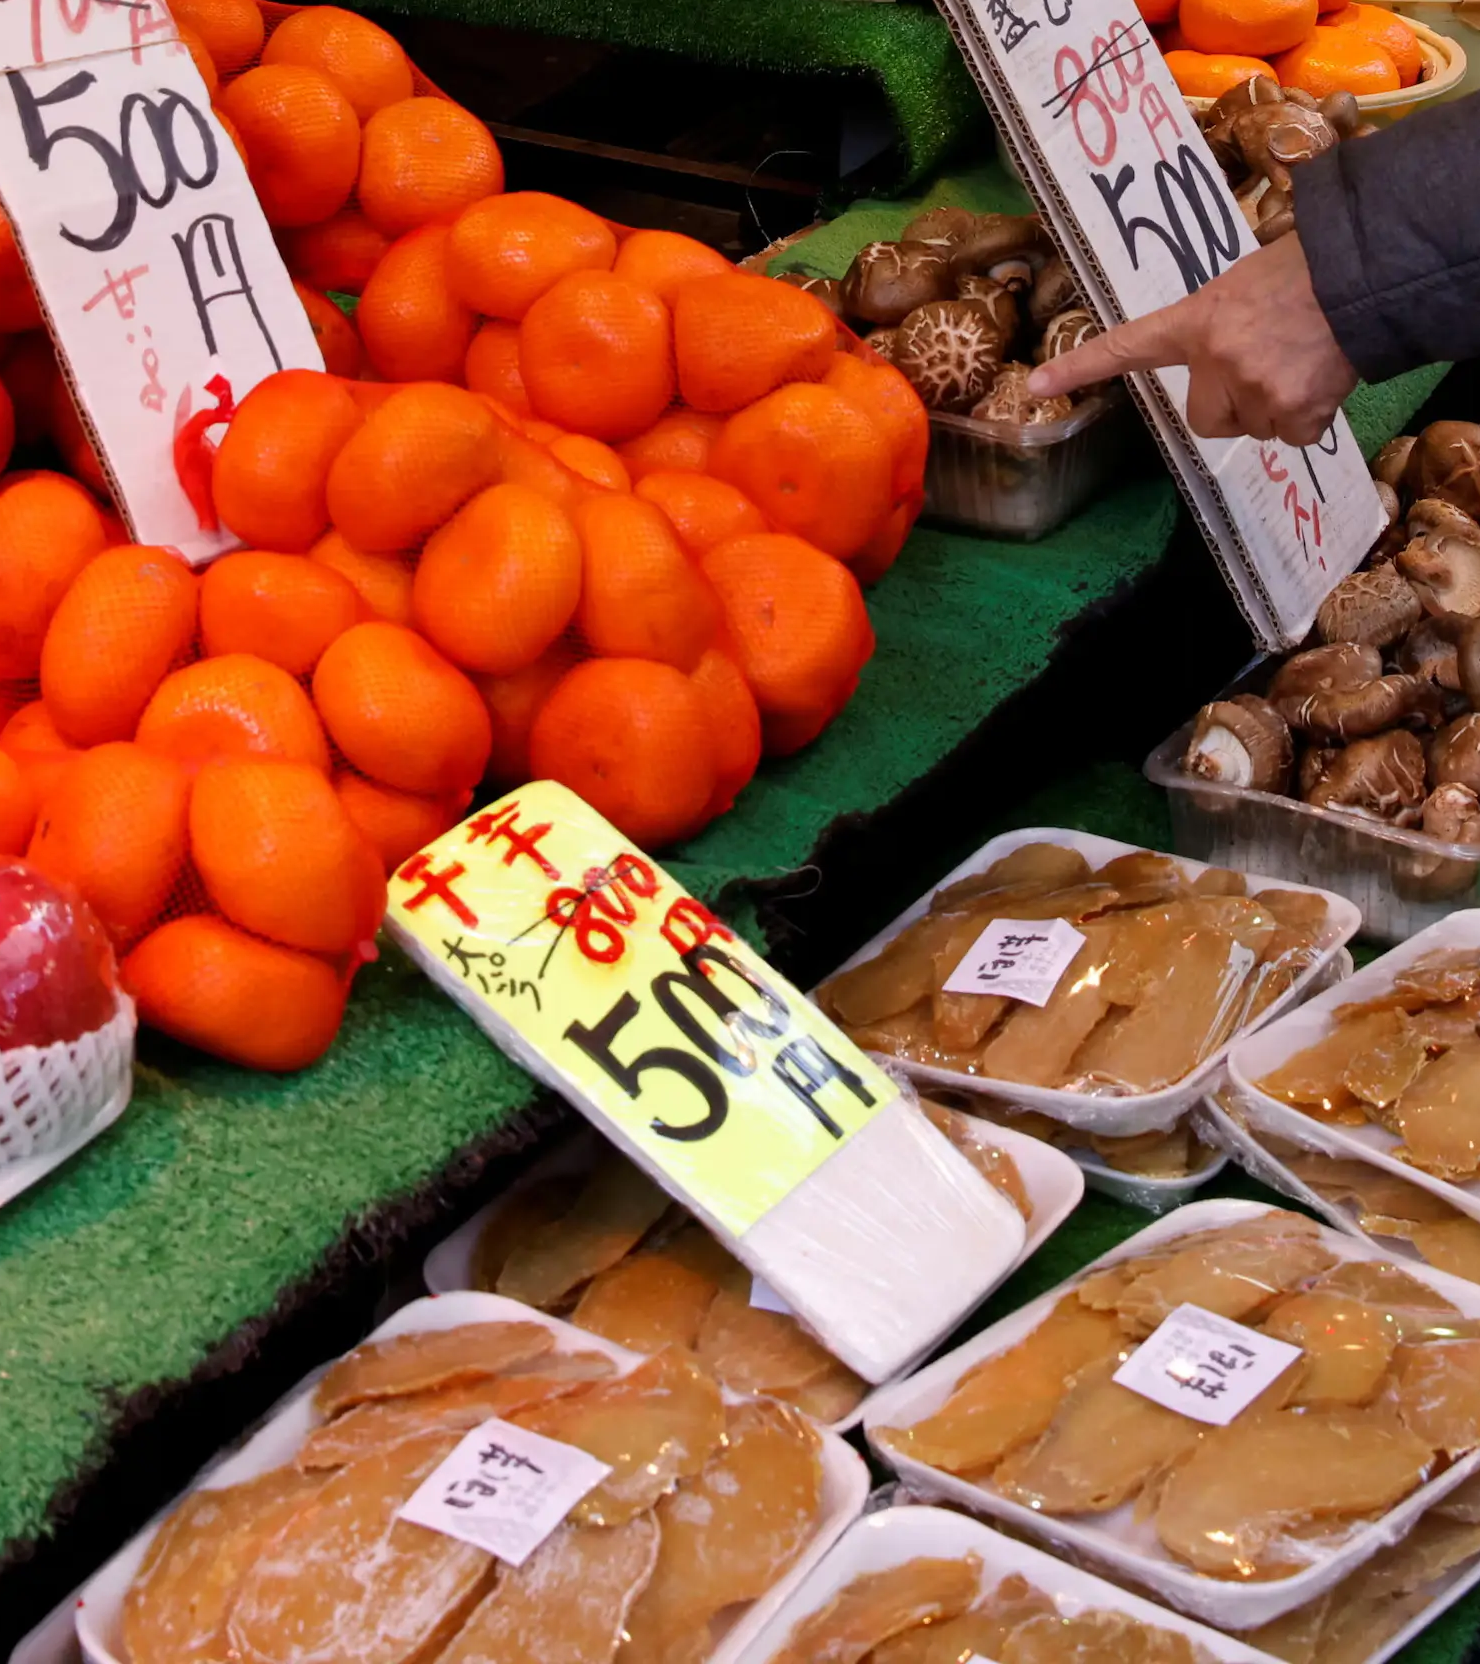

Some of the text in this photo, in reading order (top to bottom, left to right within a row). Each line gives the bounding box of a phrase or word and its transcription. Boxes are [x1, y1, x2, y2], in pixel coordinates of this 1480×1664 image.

[4, 65, 220, 254] 500
[1051, 18, 1147, 168] 800
[1089, 142, 1243, 296] 500
[562, 944, 877, 1143] 500 円
